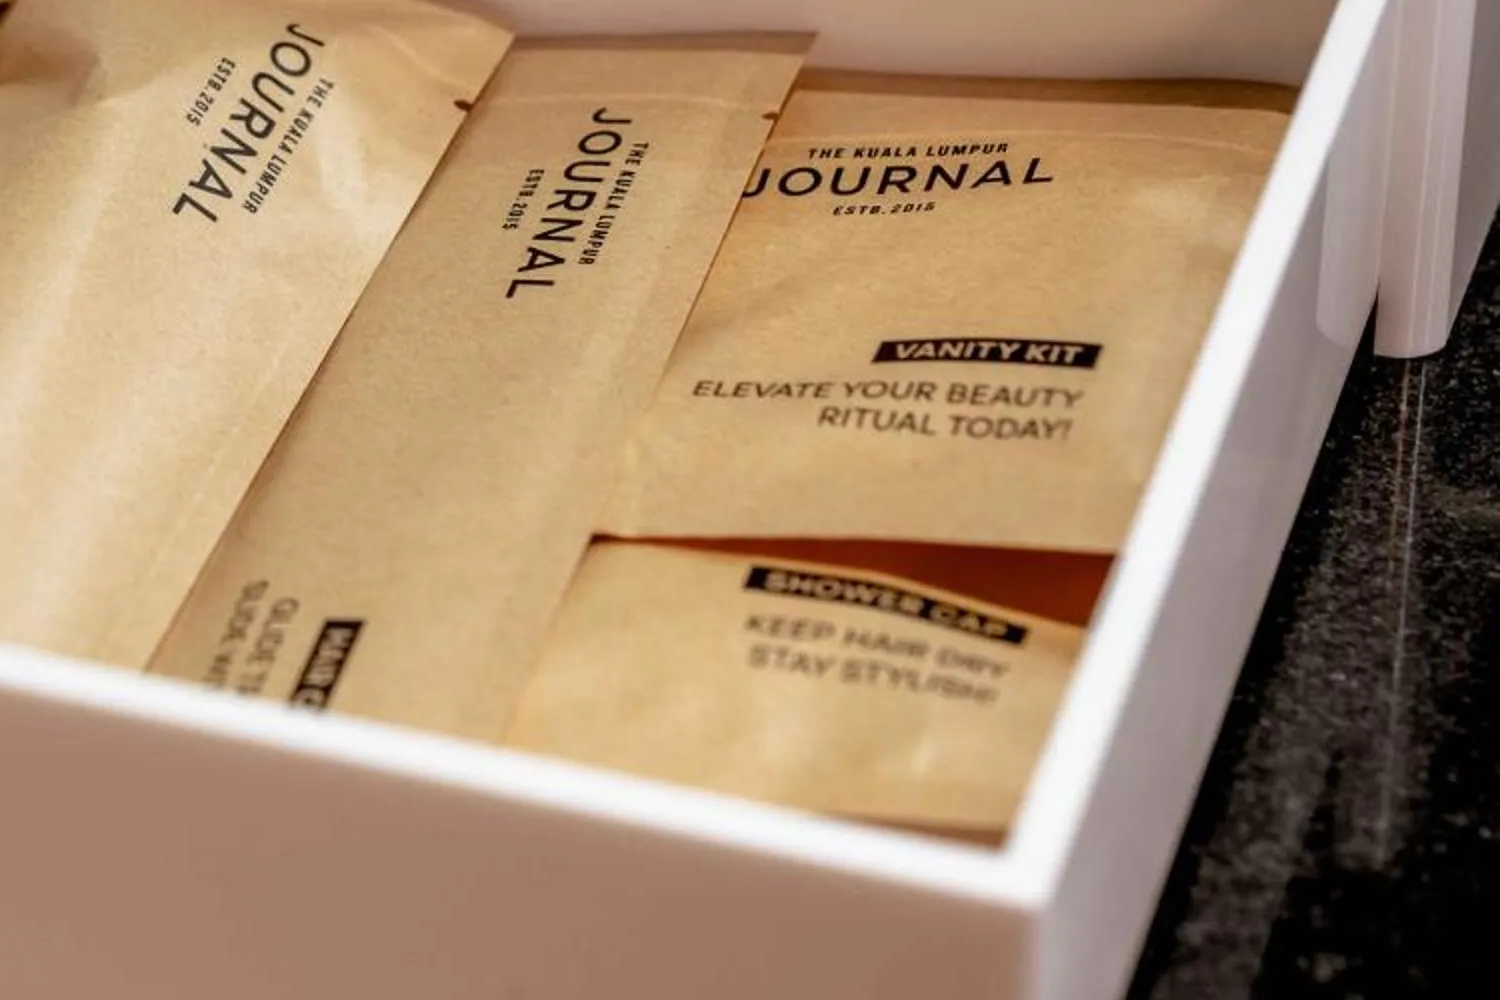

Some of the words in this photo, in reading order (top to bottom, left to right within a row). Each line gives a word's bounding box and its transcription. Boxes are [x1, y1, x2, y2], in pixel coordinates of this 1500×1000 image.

[306, 77, 336, 108] THE
[172, 23, 325, 223] JOURNAL
[278, 107, 315, 154] KUALA
[625, 141, 649, 166] THE
[808, 148, 844, 160] THE
[853, 146, 917, 159] KUALA
[926, 143, 1009, 157] LUMPUR
[243, 154, 287, 214] LUMPUR
[605, 170, 636, 210] KUALA
[742, 157, 1053, 198] JOURNAL
[505, 107, 633, 299] JOURNAL
[578, 215, 616, 265] LUMPUR
[896, 341, 1021, 361] VANITY
[1024, 344, 1084, 363] KIT
[693, 380, 833, 399] ELEVATE
[843, 380, 937, 402] YOUR
[946, 383, 1086, 408] BEAUTY
[817, 406, 937, 435] RITUAL
[948, 414, 1073, 441] TODAY!
[765, 571, 924, 613] SHOWER
[930, 603, 1008, 637] CAP
[745, 614, 836, 640] KEEP
[843, 626, 930, 658] HAIR
[747, 644, 836, 676] STAY
